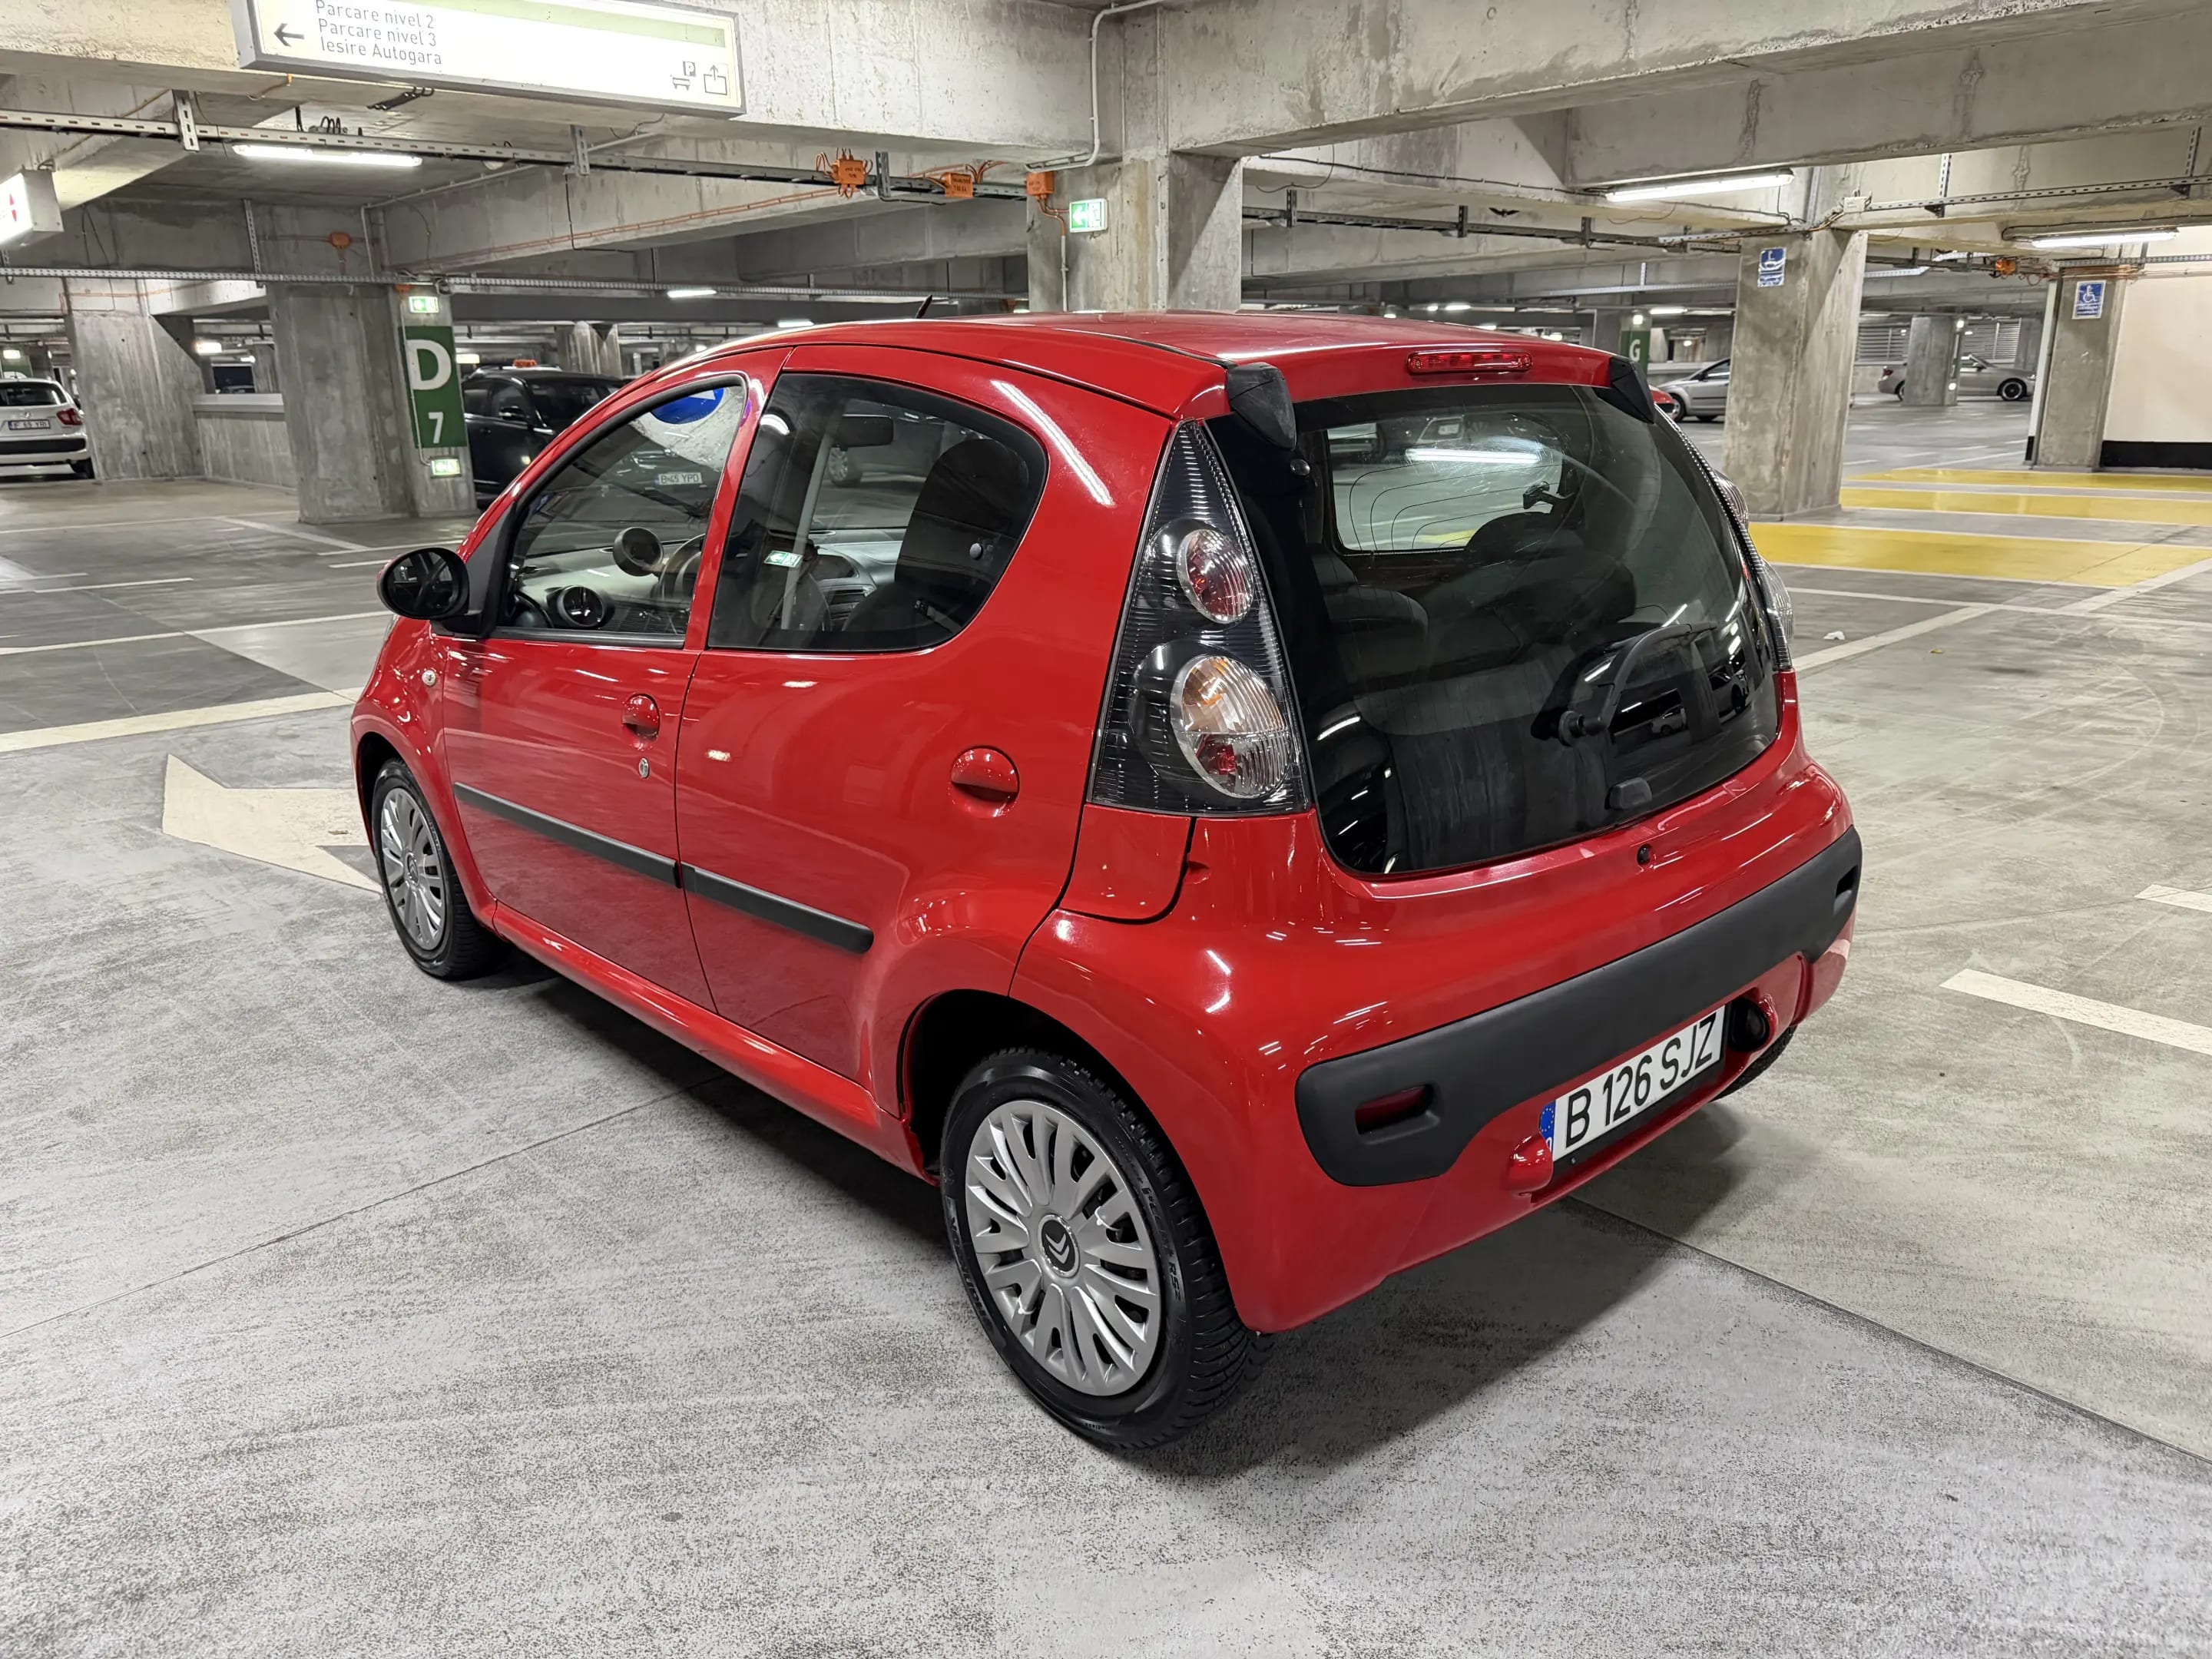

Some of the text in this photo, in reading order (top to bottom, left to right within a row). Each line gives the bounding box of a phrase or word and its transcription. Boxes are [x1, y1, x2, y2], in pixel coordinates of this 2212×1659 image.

[316, 0, 435, 29] Parcare nivel 2
[318, 18, 437, 47] Parcare nivel 3
[372, 43, 442, 65] Autogara
[406, 339, 452, 390] D
[1629, 339, 1641, 363] G
[428, 412, 444, 444] 7
[1566, 1012, 1717, 1148] B 126 SJZ
